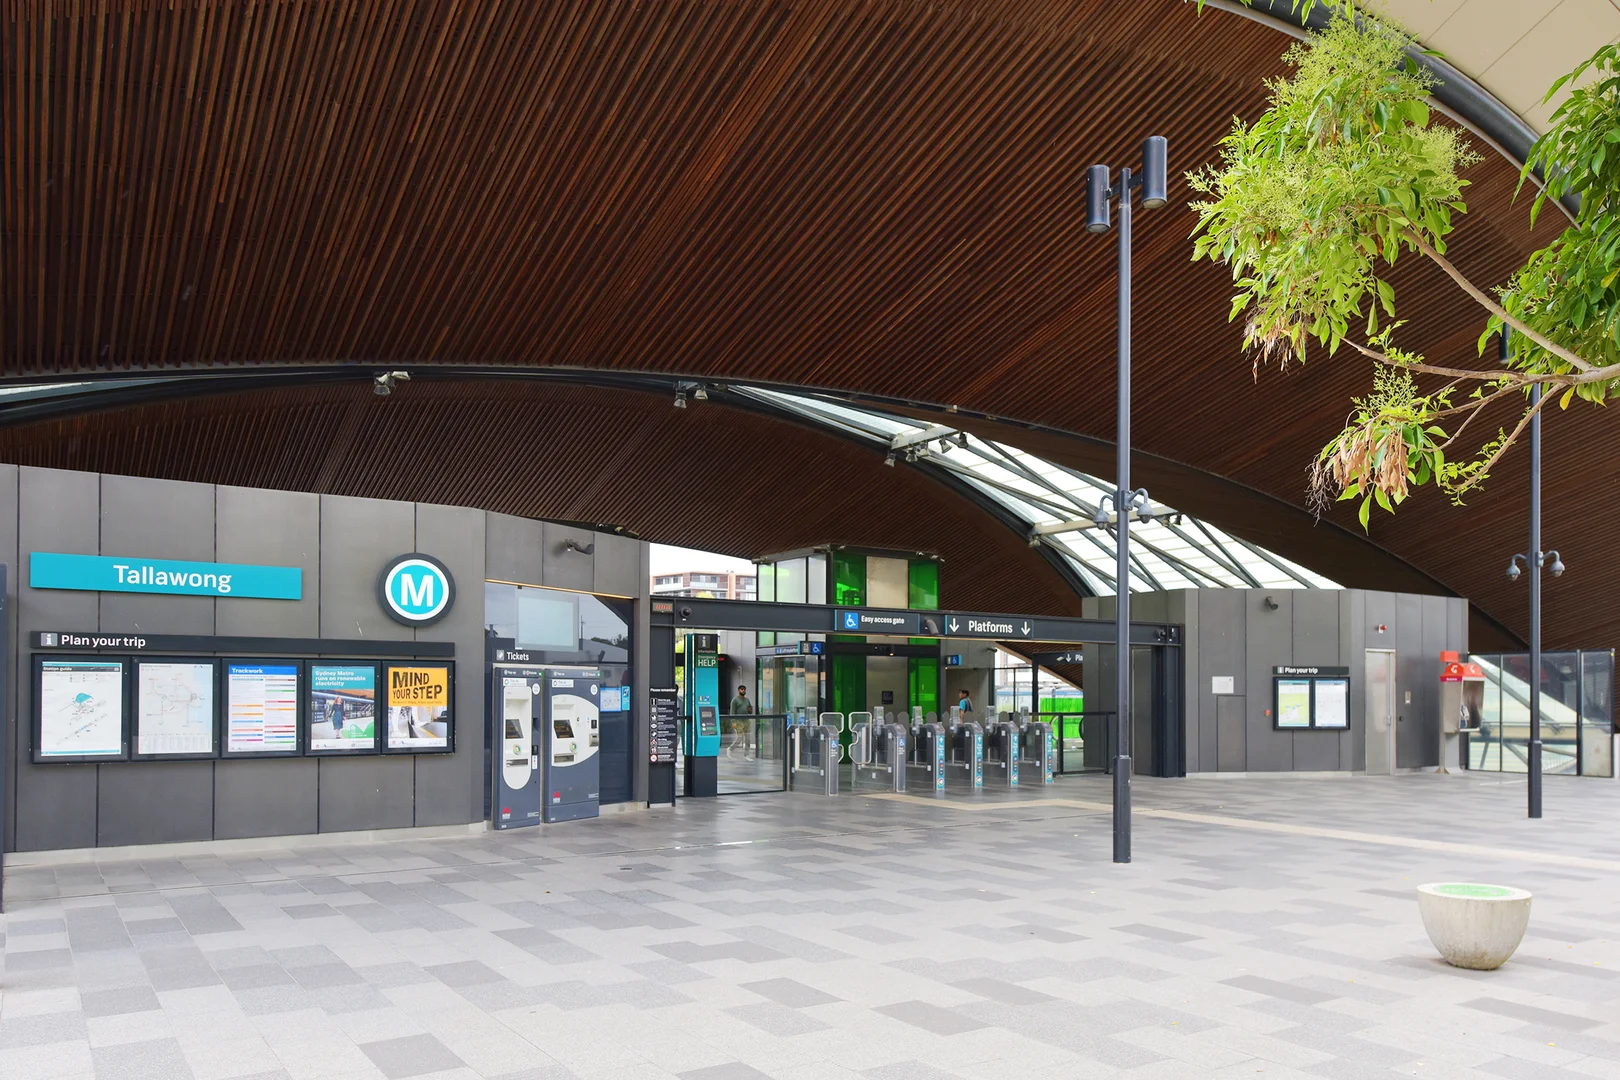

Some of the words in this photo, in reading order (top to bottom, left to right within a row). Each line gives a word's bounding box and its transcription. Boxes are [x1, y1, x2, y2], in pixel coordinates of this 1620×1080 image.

[112, 564, 232, 594] Tallawong
[401, 573, 434, 607] M
[861, 615, 873, 624] Easy
[874, 617, 893, 625] access
[968, 620, 1013, 634] Platforms
[61, 634, 90, 646] Plan
[92, 637, 121, 649] your
[123, 636, 146, 649] trip
[506, 651, 530, 661] Tickets
[698, 659, 716, 667] HELP
[1308, 667, 1319, 675] trip
[392, 671, 430, 689] MIND
[392, 689, 411, 700] YOUR
[412, 684, 443, 700] STEP
